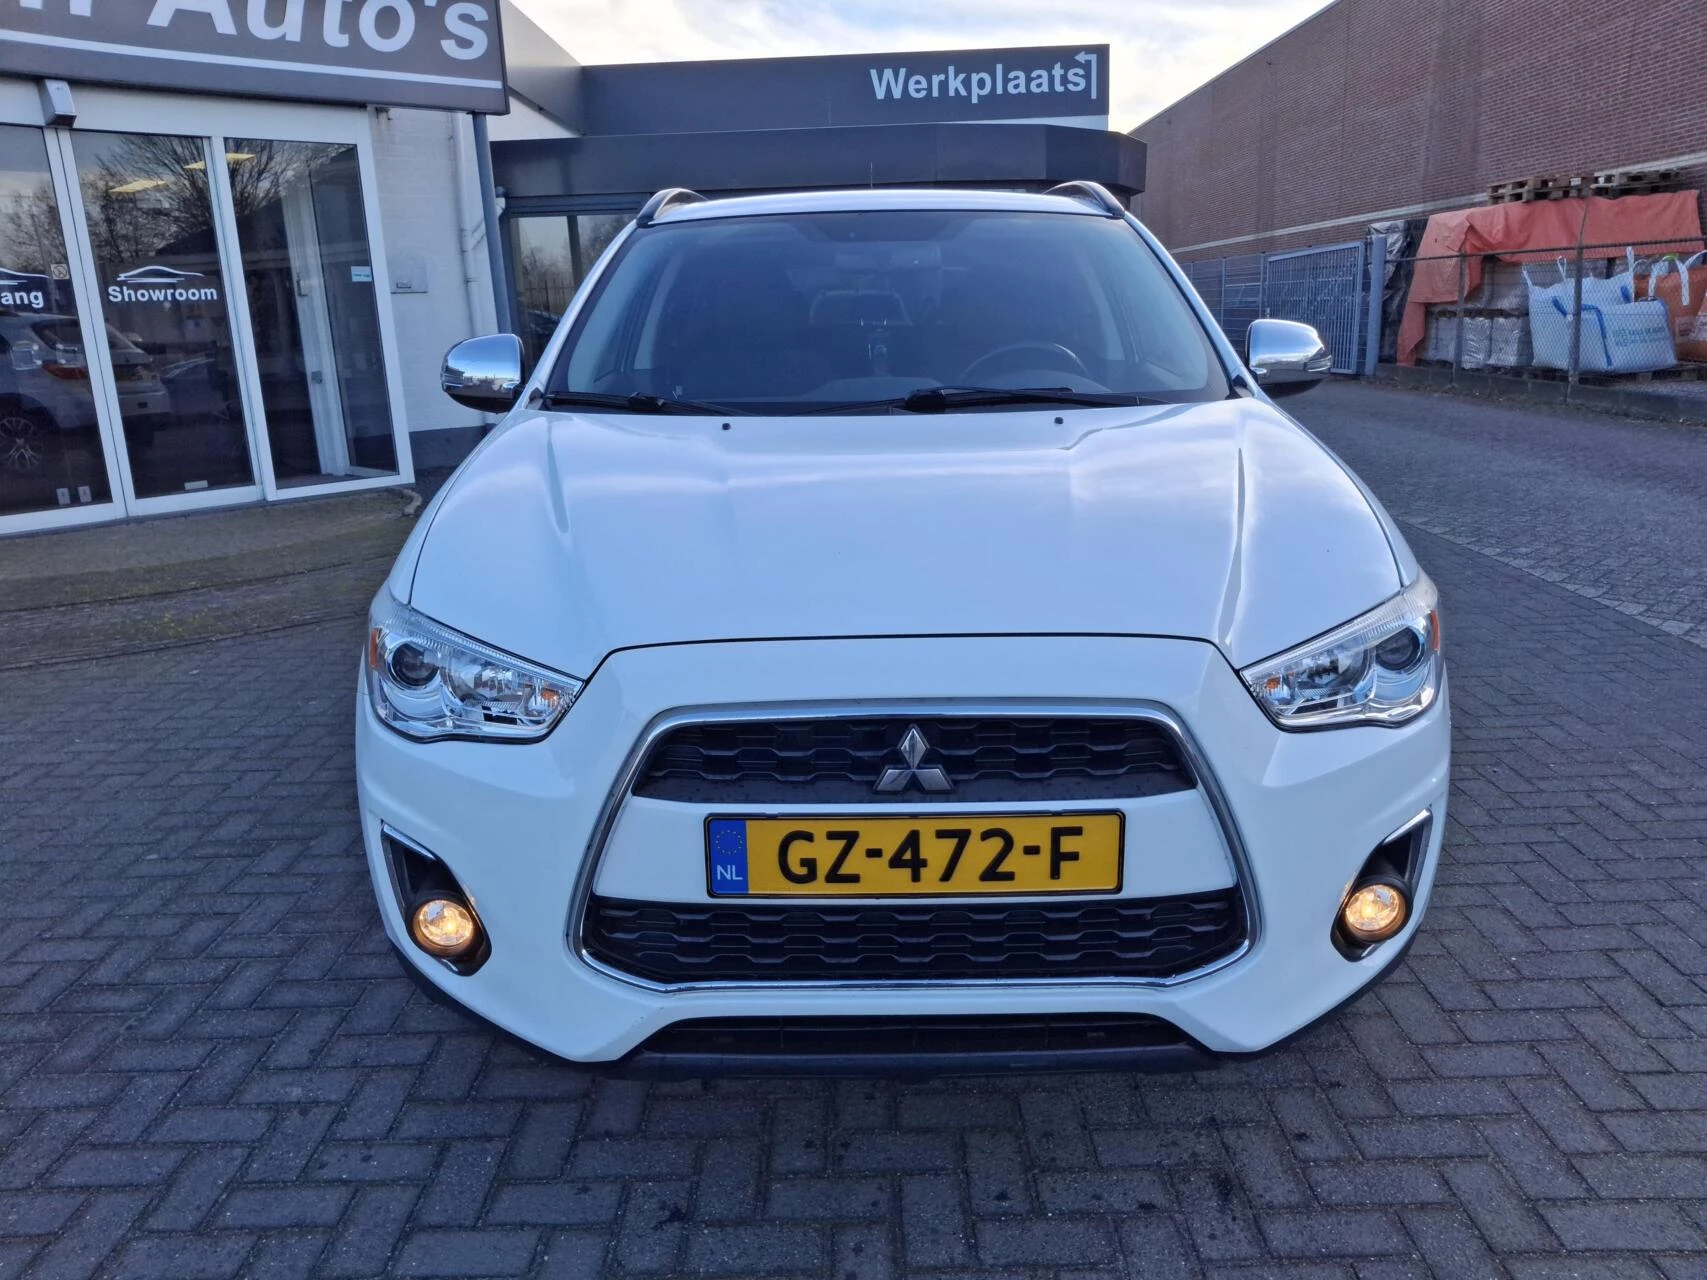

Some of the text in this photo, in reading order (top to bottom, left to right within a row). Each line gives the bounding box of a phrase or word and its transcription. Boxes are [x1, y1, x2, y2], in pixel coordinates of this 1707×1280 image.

[870, 61, 1086, 104] Werkplaats
[108, 286, 218, 302] Showroom
[778, 826, 1083, 884] GZ-472-F
[716, 864, 744, 880] NL
